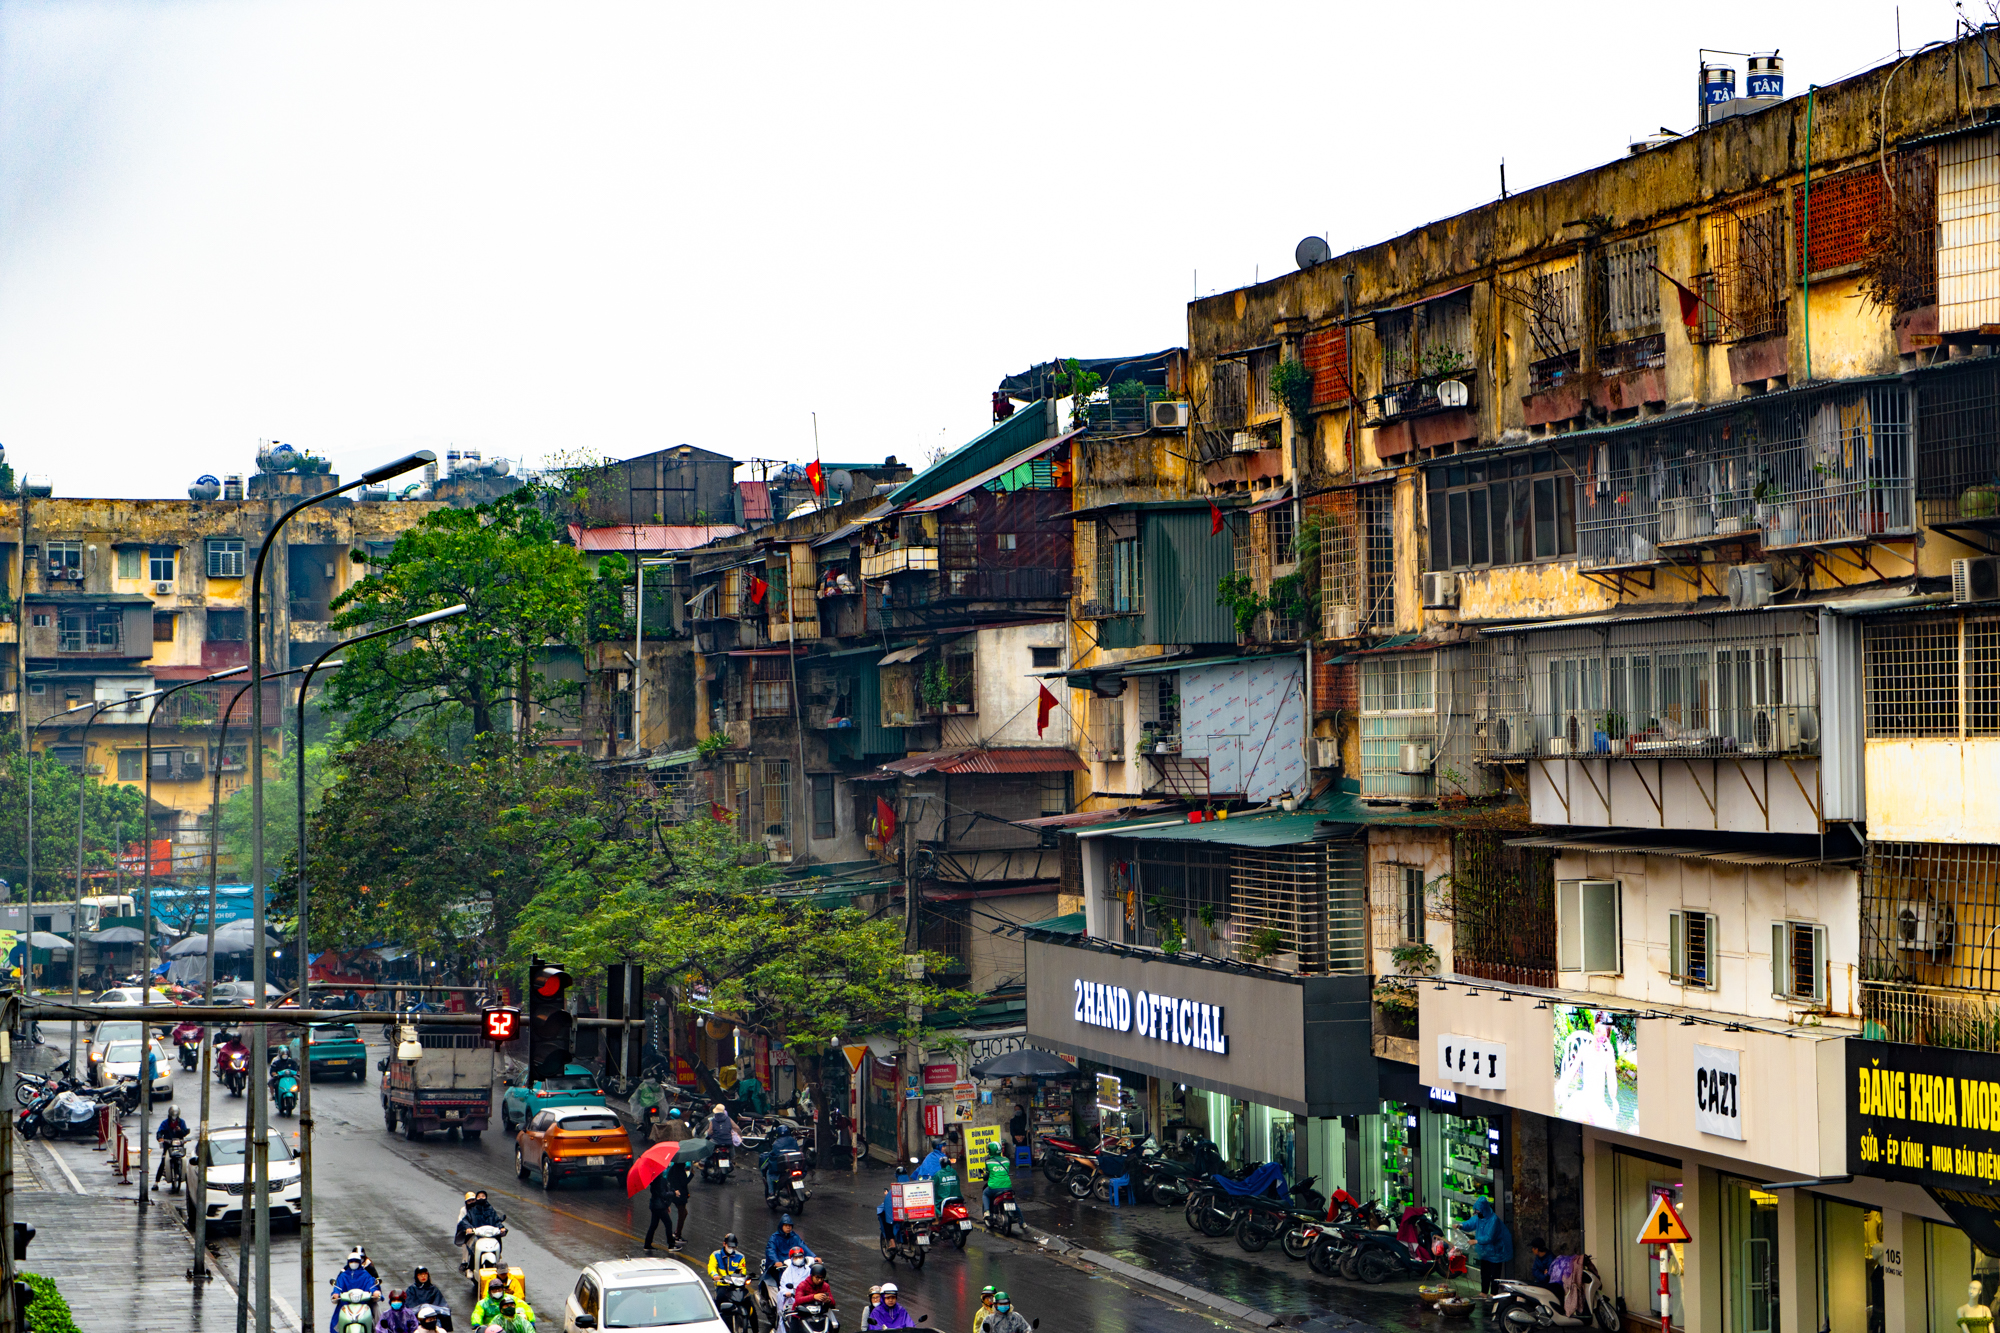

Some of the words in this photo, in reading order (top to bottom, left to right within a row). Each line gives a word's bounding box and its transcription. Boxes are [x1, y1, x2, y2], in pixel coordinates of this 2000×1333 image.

[1753, 78, 1780, 93] TÂN
[490, 1014, 511, 1034] 52
[1074, 978, 1132, 1032] 2HAND
[1136, 990, 1226, 1054] OFFICIAL
[1696, 1066, 1738, 1119] CAZI
[1859, 1058, 1906, 1119] ĐĂNG
[1909, 1072, 1957, 1126] KHOA
[1961, 1078, 2000, 1132] MOB
[1861, 1128, 1879, 1162] SỬA
[1887, 1134, 1899, 1164] ÉP
[1901, 1136, 1923, 1169] KÍNH
[1932, 1145, 1953, 1173] MUA
[1955, 1144, 1975, 1177] BÁN
[1977, 1148, 2000, 1185] ĐIỆN
[1886, 1248, 1900, 1265] 105
